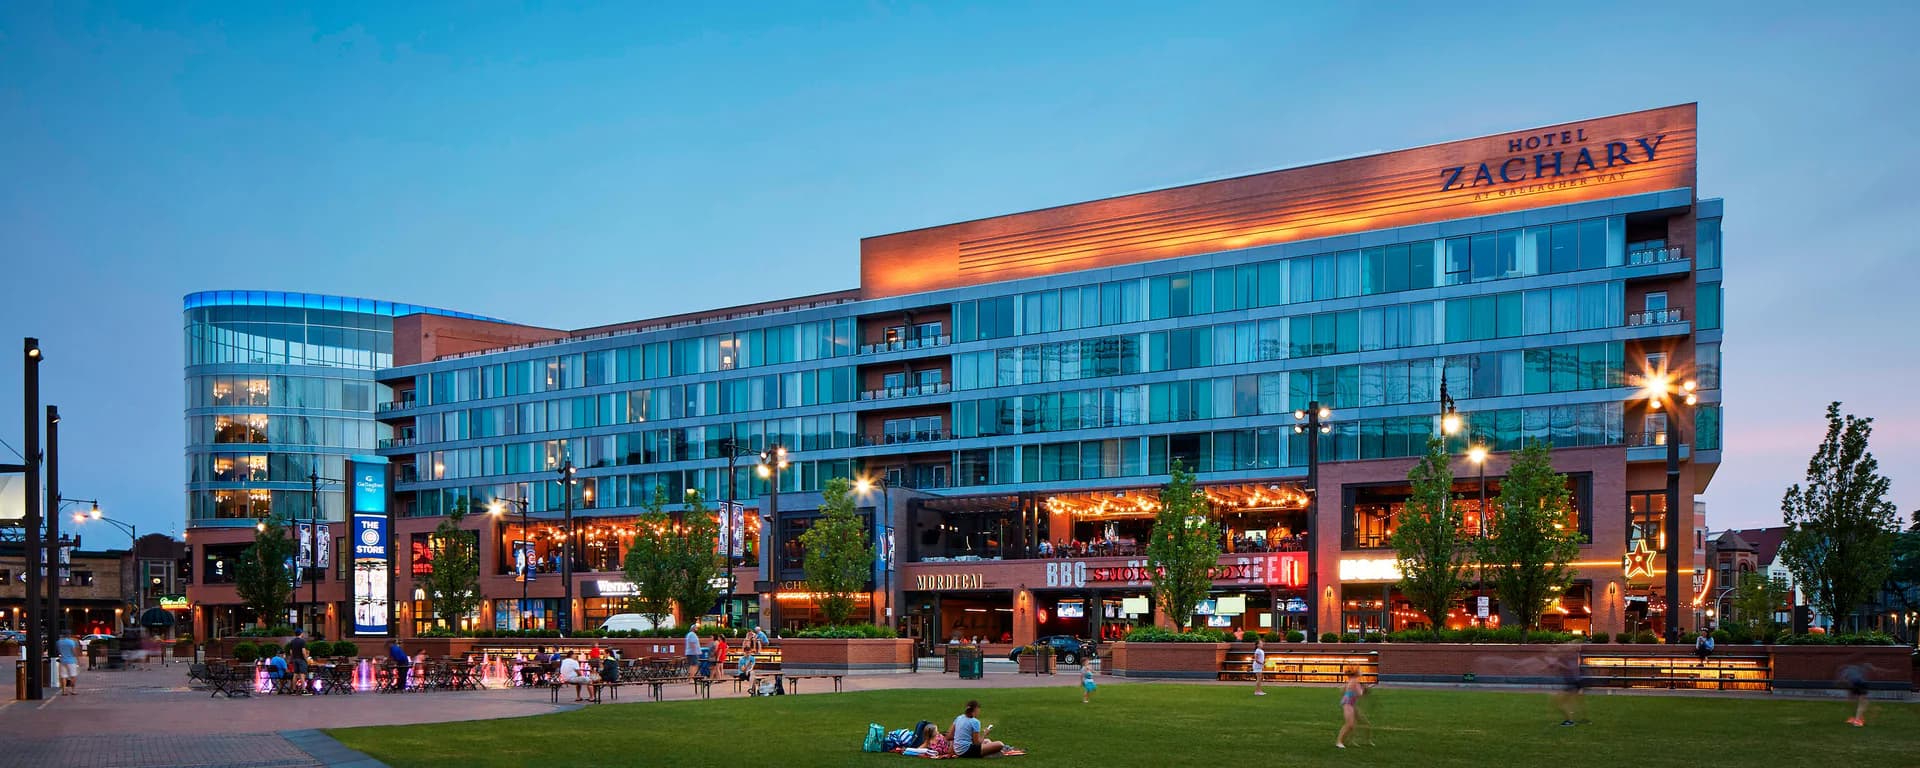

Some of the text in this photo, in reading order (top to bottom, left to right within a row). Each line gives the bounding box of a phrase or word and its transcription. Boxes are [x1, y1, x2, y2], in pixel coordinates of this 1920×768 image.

[1508, 128, 1588, 153] HOTEL
[1440, 134, 1667, 192] ZACHARY
[1473, 172, 1626, 201] AT GALLAGHER WAY
[361, 520, 379, 529] THE
[356, 545, 385, 554] STORE
[916, 573, 983, 590] MORDECAI
